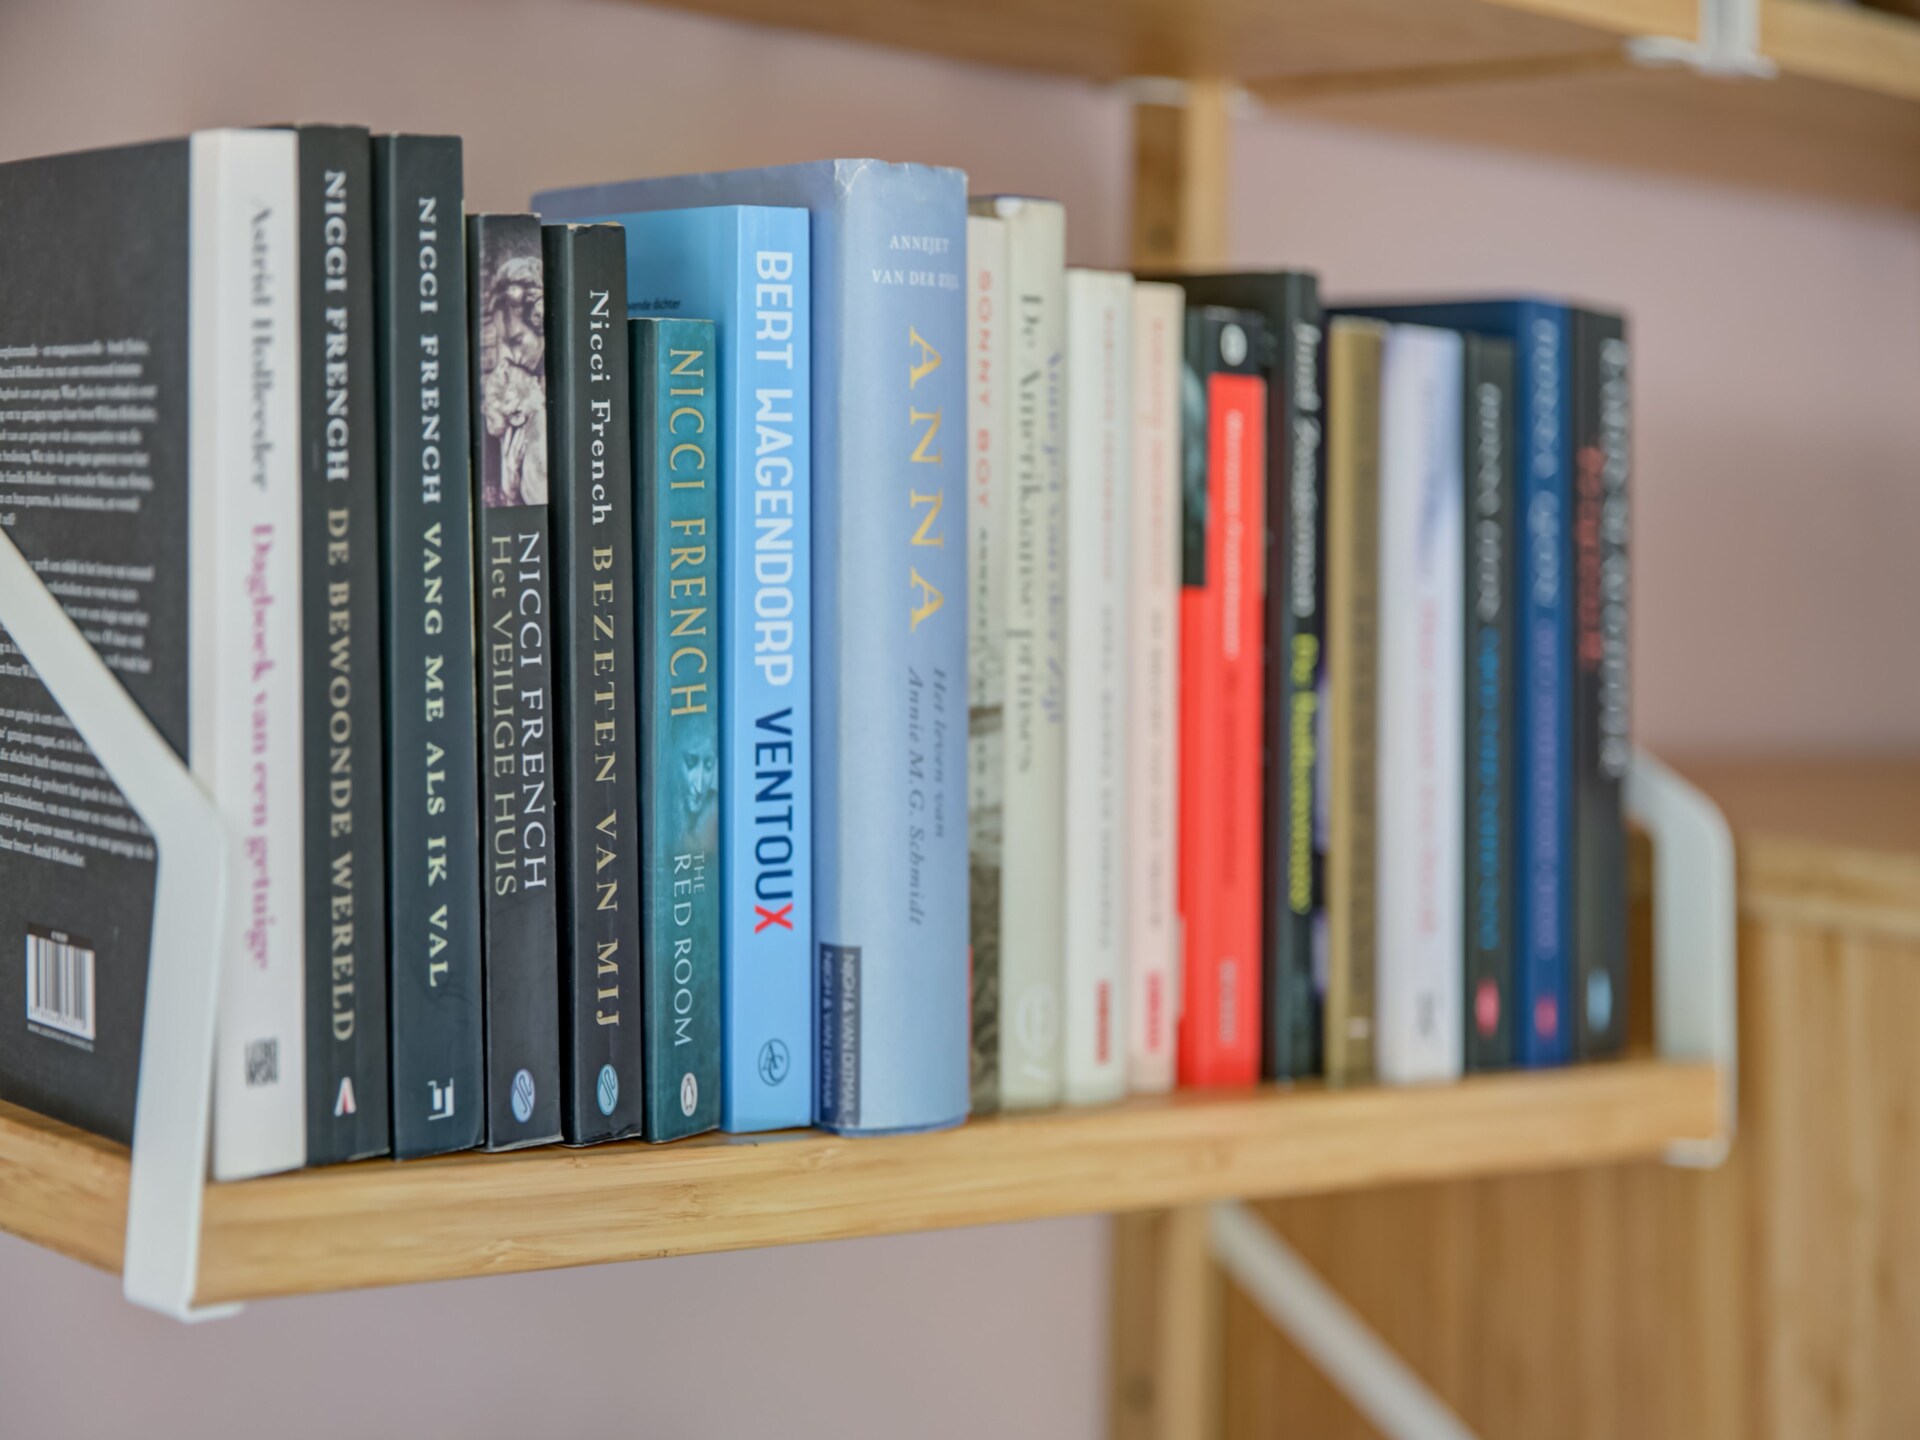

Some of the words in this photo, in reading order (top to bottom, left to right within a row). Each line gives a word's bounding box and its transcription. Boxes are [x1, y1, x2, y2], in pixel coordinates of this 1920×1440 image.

[250, 198, 274, 307] Astrid
[325, 170, 348, 292] NICCI
[419, 196, 438, 314] NICCI
[872, 269, 904, 284] VAN
[909, 271, 936, 286] DER
[890, 235, 949, 255] ANNEJET
[589, 290, 610, 382] Nicci
[756, 251, 793, 369] BERT
[978, 270, 993, 407] SONNY
[326, 307, 349, 482] FRENCH
[421, 335, 441, 504] FRENCH
[669, 348, 705, 489] NICCI
[591, 399, 612, 525] French
[909, 325, 945, 633] ANNA
[977, 428, 991, 508] BOY
[327, 507, 349, 566] DE
[423, 523, 443, 635] VANG
[492, 536, 512, 599] Het
[754, 389, 794, 687] WAGENDORP
[245, 523, 275, 682] Dagboek
[519, 531, 542, 667] NICCI
[670, 519, 708, 716] FRENCH
[328, 581, 354, 838] BEWOONDE
[425, 655, 444, 722] ME
[492, 610, 516, 777] VEILIGE
[593, 545, 616, 783] BEZETEN
[910, 667, 926, 743] Annie
[252, 690, 270, 755] van
[252, 761, 270, 828] een
[426, 741, 446, 816] ALS
[521, 689, 547, 889] FRENCH
[754, 707, 794, 934] VENTOUX
[428, 836, 447, 887] IK
[494, 791, 517, 896] HUIS
[595, 810, 617, 912] VAN
[673, 854, 692, 928] RED
[692, 850, 706, 894] THE
[909, 825, 927, 926] Schmidt
[244, 834, 277, 970] getuige
[330, 852, 355, 1042] WERELD
[428, 905, 448, 987] VAL
[597, 938, 619, 1027] MIJ
[673, 939, 693, 1048] ROOM
